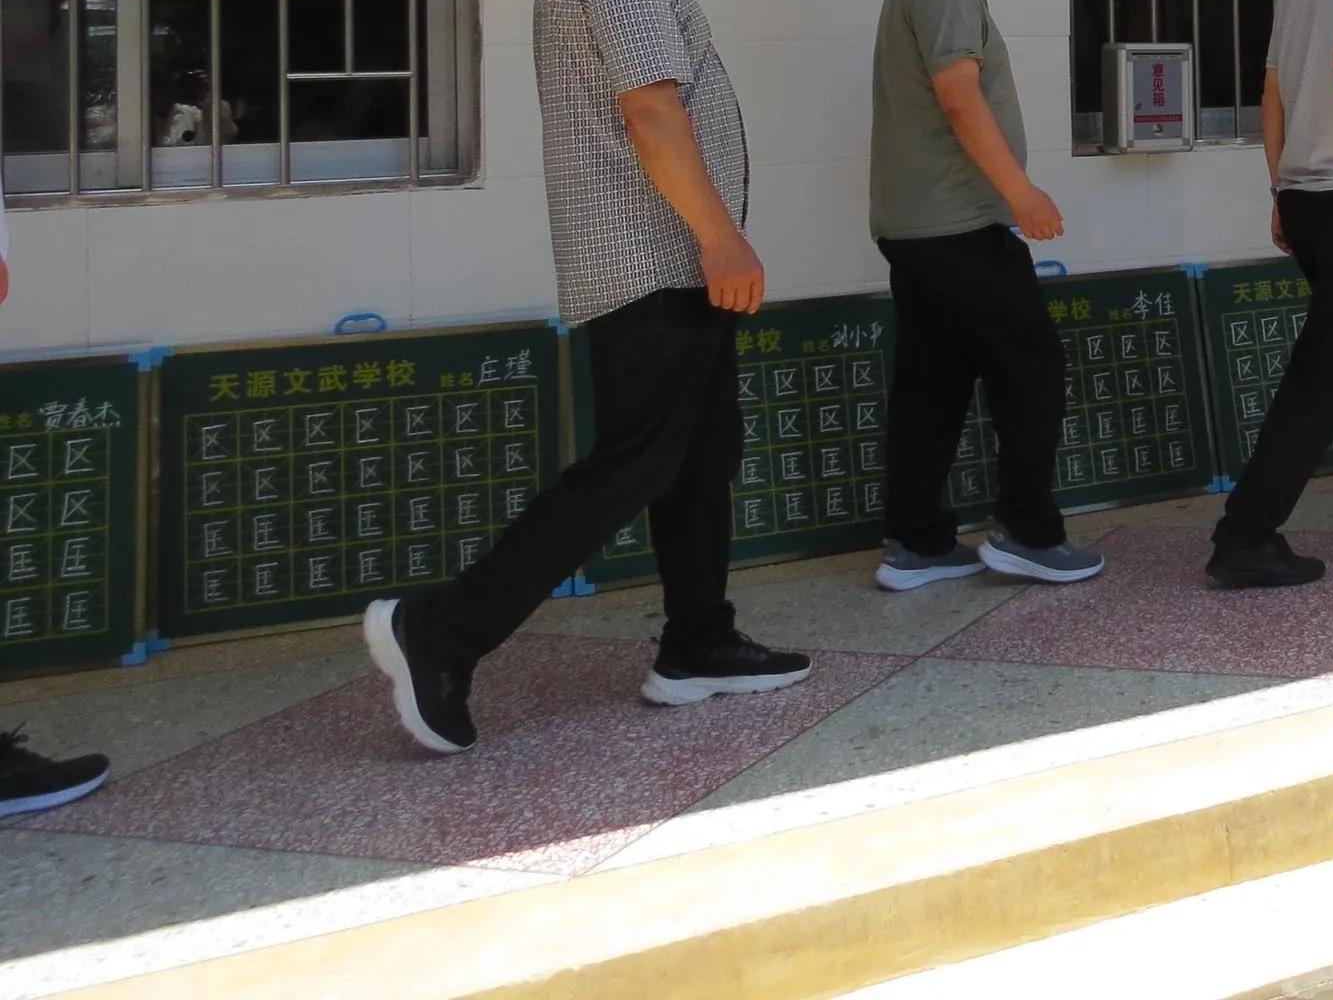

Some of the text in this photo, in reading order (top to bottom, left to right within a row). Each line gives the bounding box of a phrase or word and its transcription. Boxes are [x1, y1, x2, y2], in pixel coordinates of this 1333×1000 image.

[1130, 289, 1176, 319] 李佳
[208, 358, 474, 402] 天源文武学校 姓名
